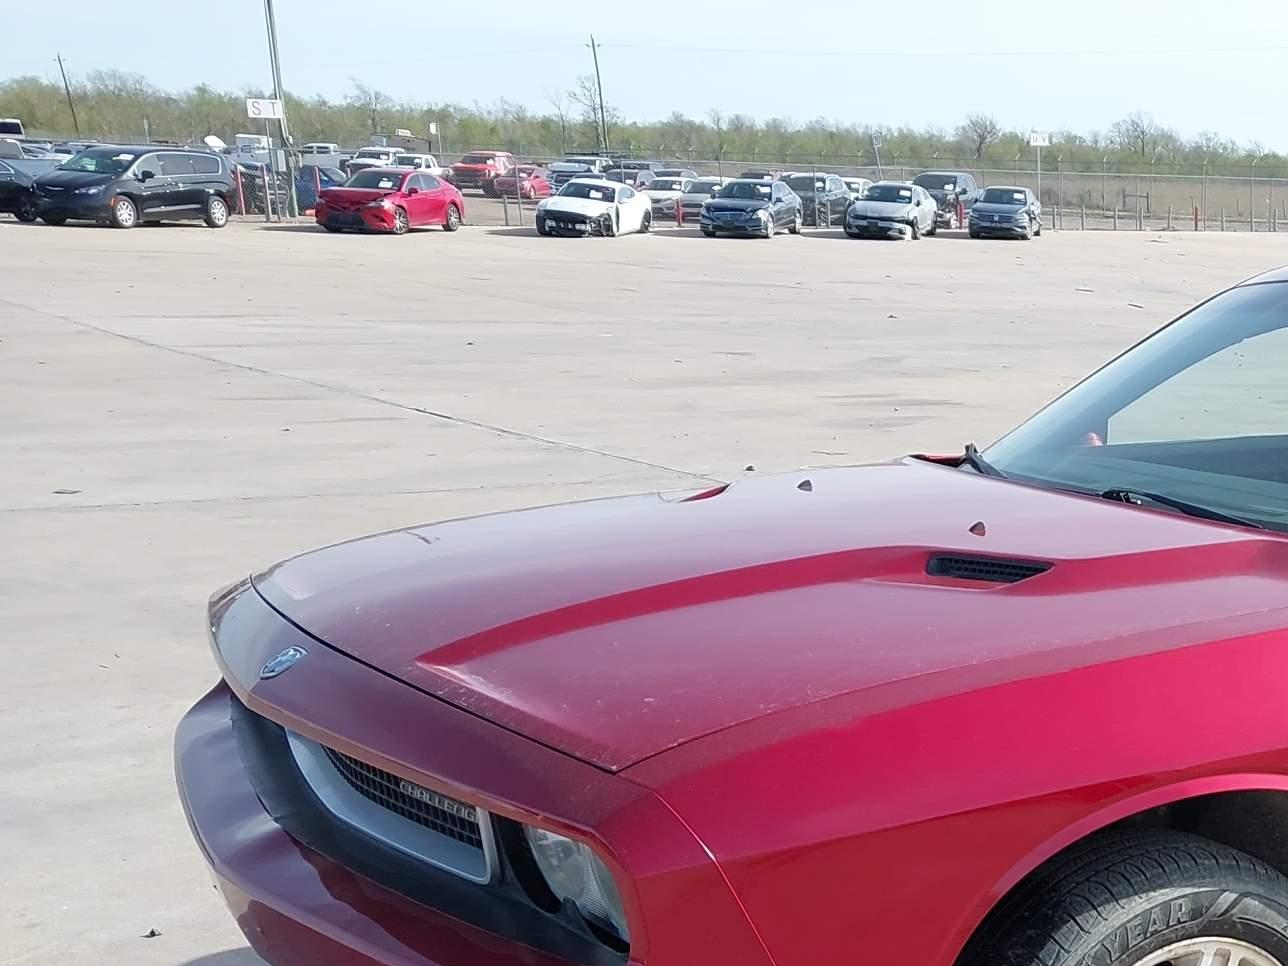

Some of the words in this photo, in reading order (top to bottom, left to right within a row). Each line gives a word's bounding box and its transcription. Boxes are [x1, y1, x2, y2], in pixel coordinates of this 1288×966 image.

[252, 101, 261, 116] S
[269, 101, 278, 116] T
[1041, 135, 1047, 143] V
